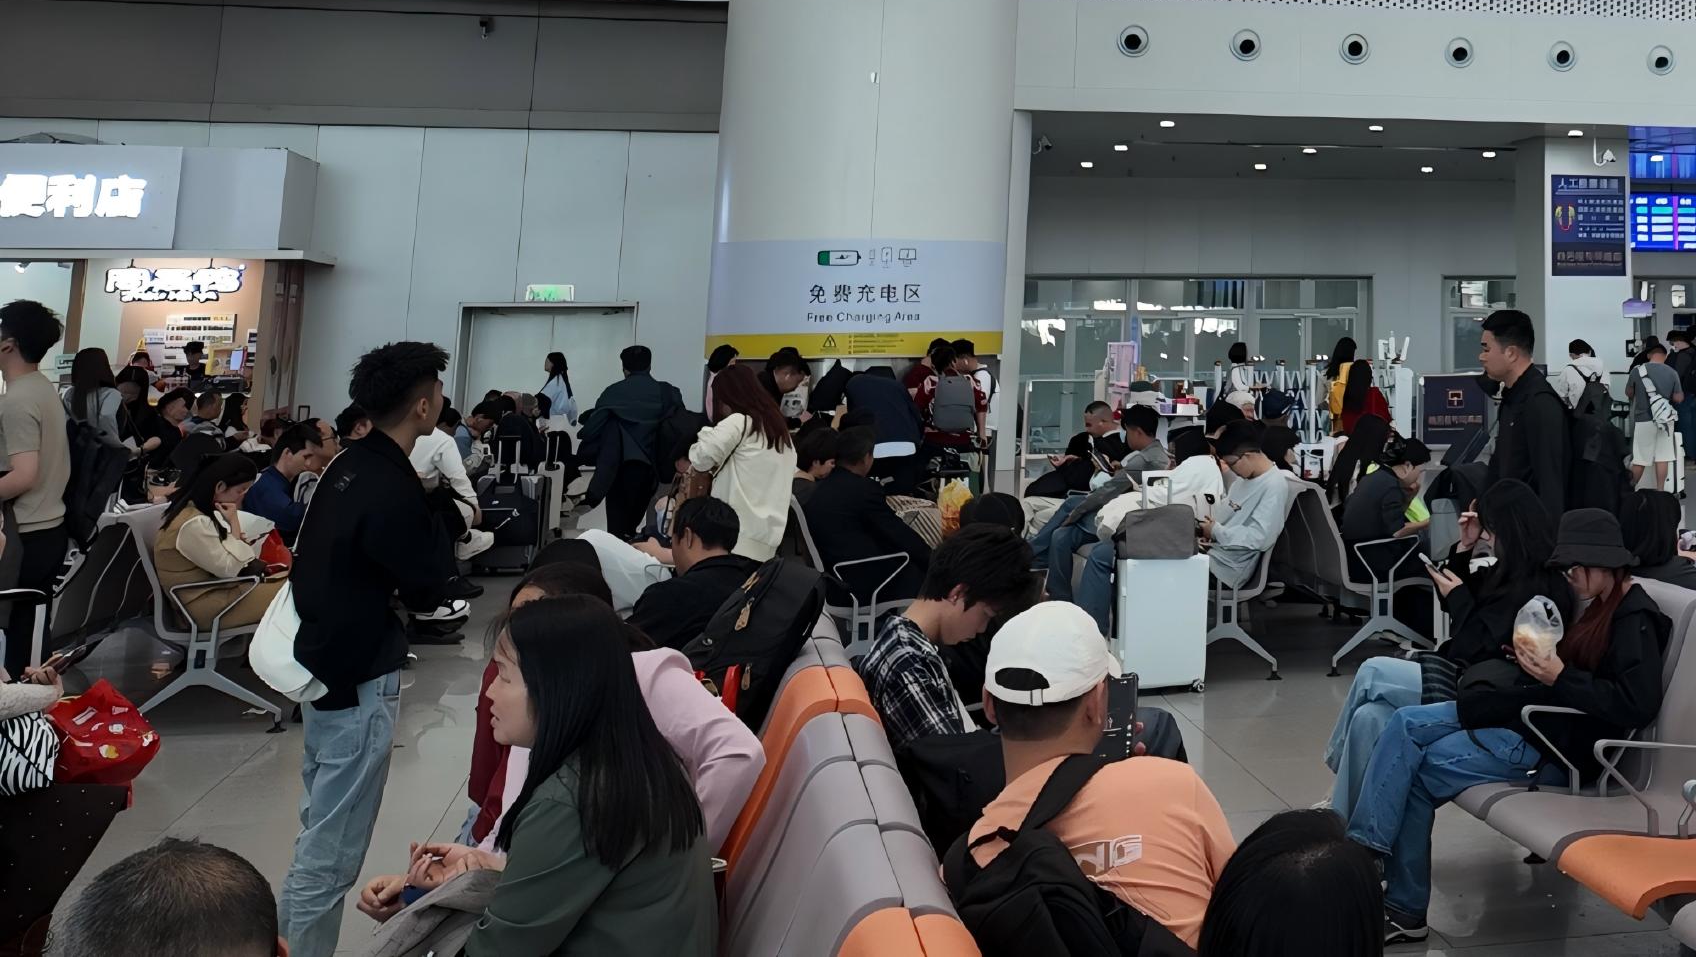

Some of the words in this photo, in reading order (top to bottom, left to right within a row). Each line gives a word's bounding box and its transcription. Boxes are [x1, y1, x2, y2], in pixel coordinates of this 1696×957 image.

[0, 173, 148, 219] 便利店
[808, 283, 921, 305] 免费充电区
